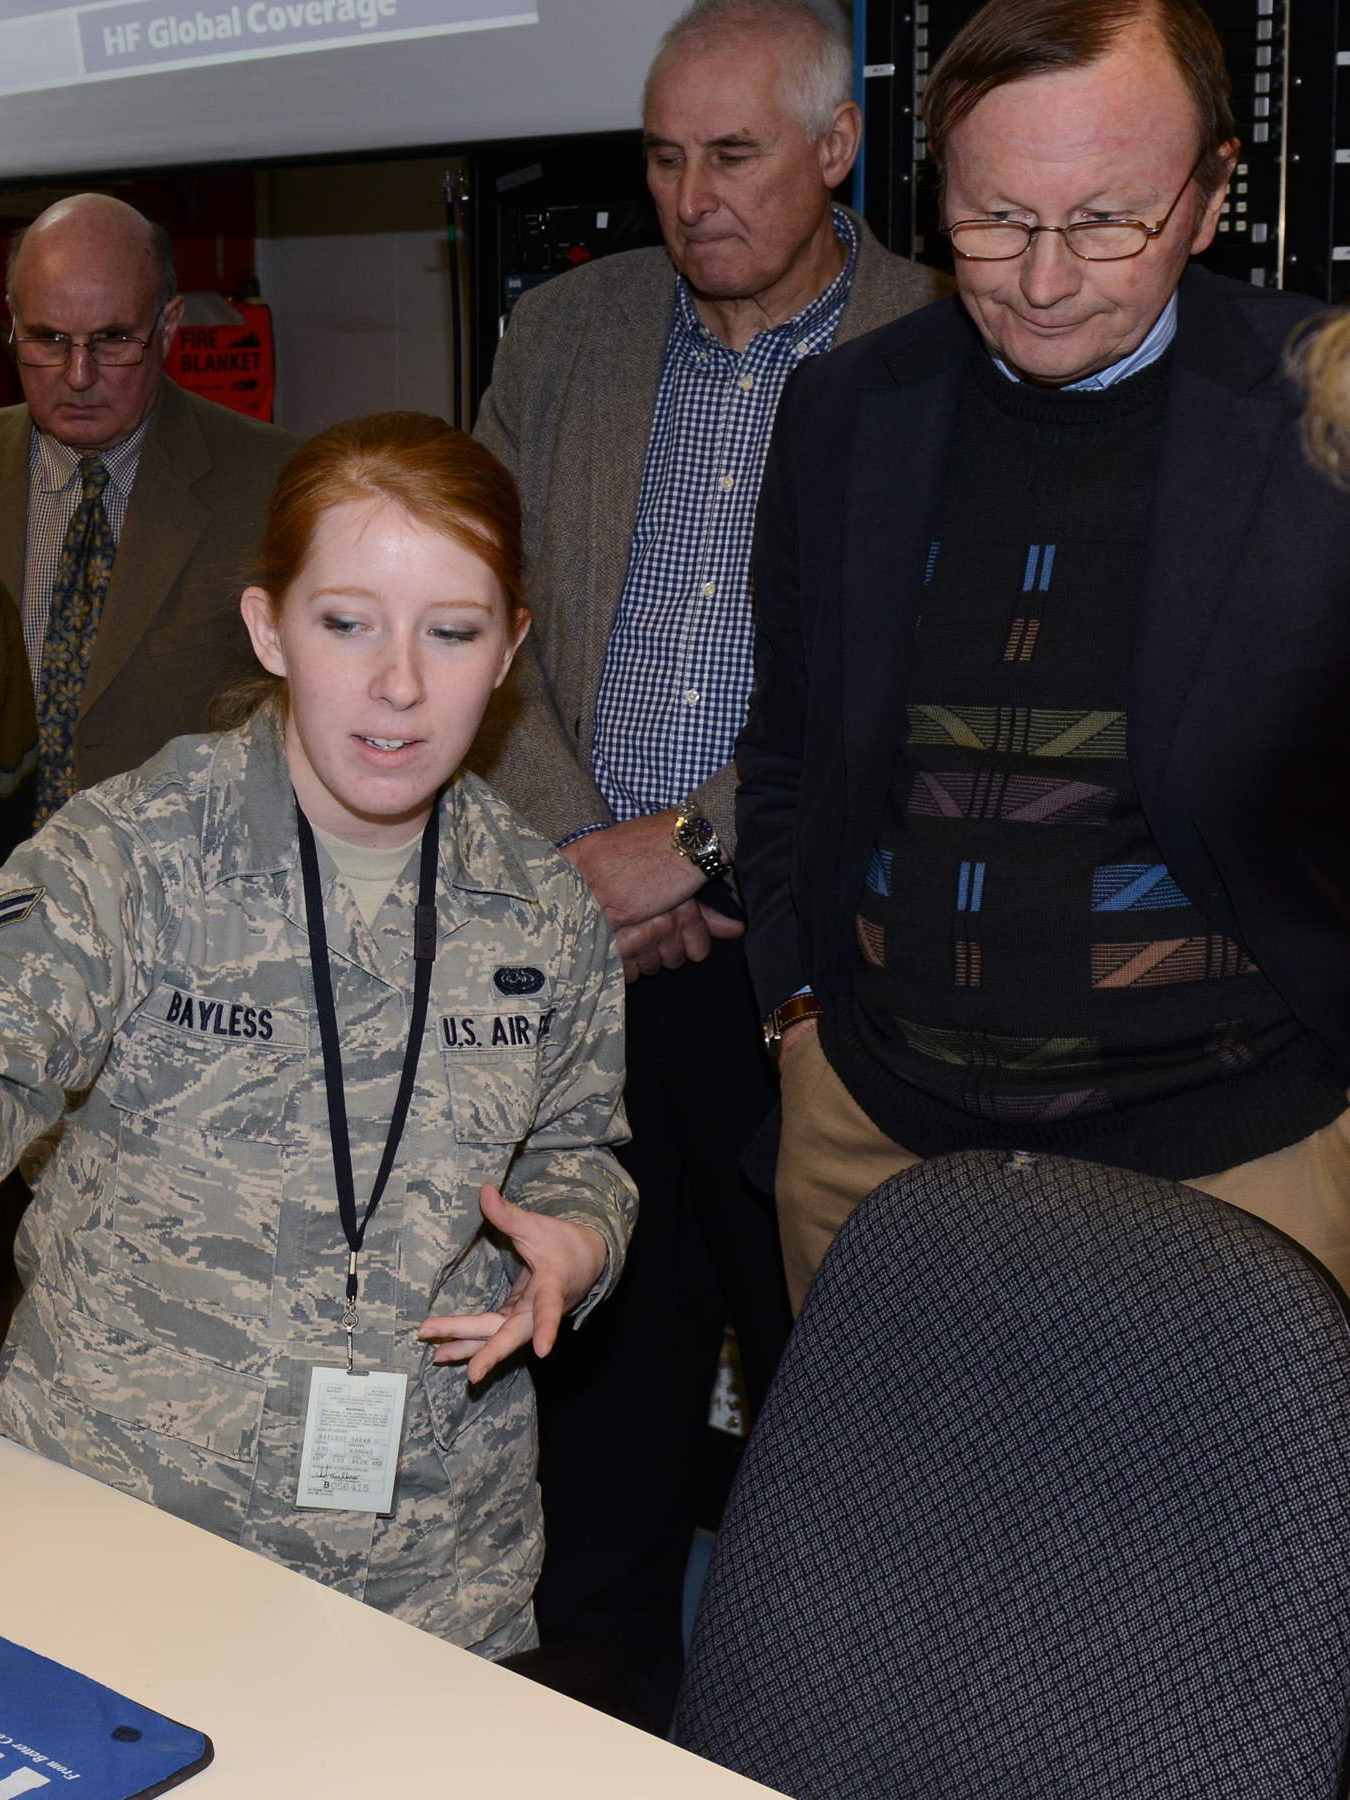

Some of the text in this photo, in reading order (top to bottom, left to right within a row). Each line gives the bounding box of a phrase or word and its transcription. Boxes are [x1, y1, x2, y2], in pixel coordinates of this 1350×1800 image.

[103, 0, 397, 56] HF Global Coverage
[181, 330, 218, 349] FIRE
[181, 352, 261, 372] BLANKET
[167, 991, 273, 1040] BAYLESS
[443, 1017, 482, 1048] U.S.
[491, 1015, 531, 1046] AIR
[12, 1743, 49, 1764] Better
[47, 1760, 81, 1781] From
